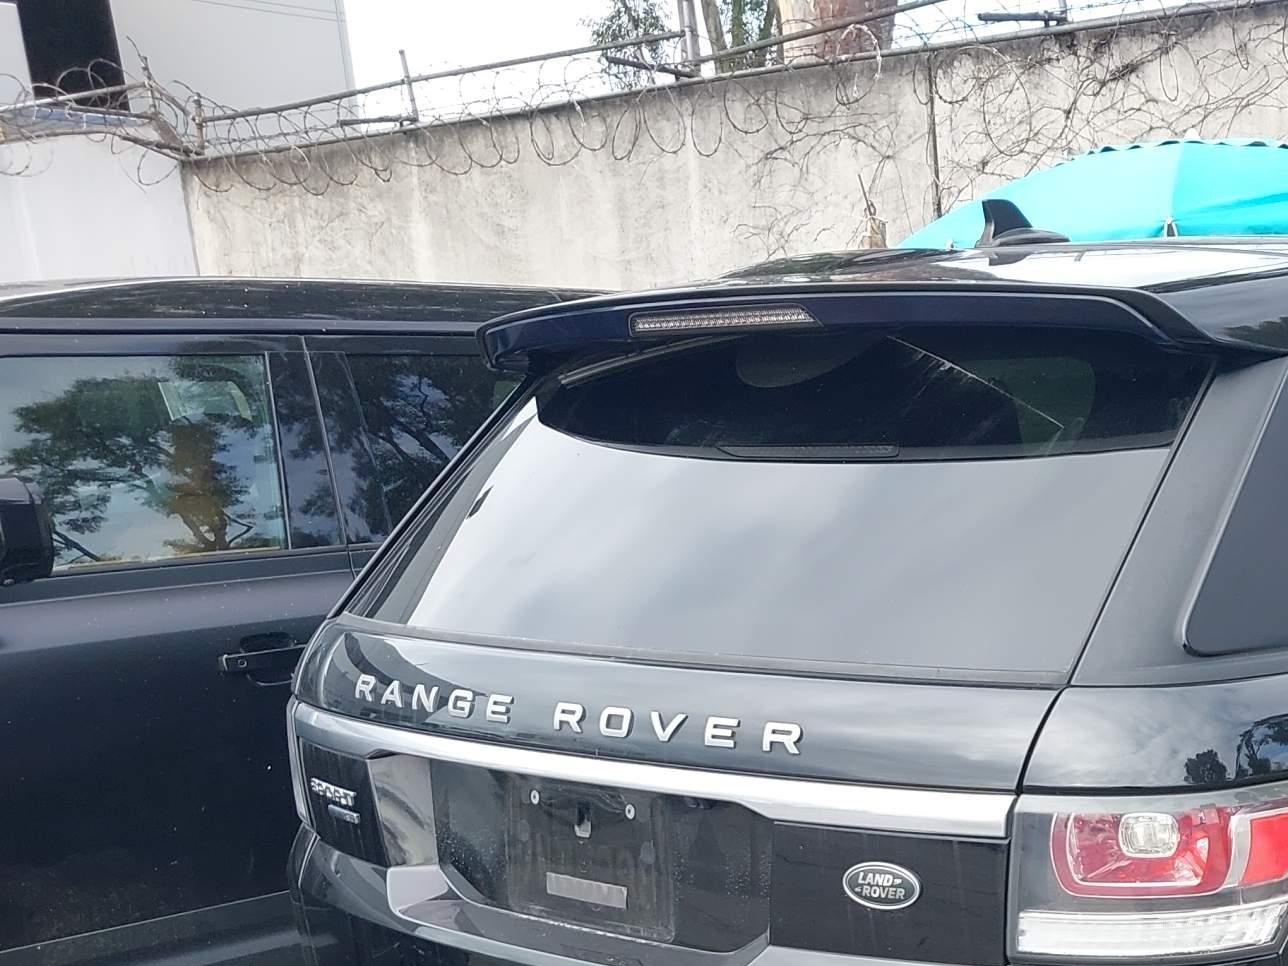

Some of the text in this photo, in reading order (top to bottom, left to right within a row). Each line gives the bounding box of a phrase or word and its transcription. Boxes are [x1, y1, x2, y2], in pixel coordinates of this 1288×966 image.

[355, 673, 803, 755] RANGE ROVER
[857, 872, 894, 887] LAND
[862, 885, 906, 900] ROVER
